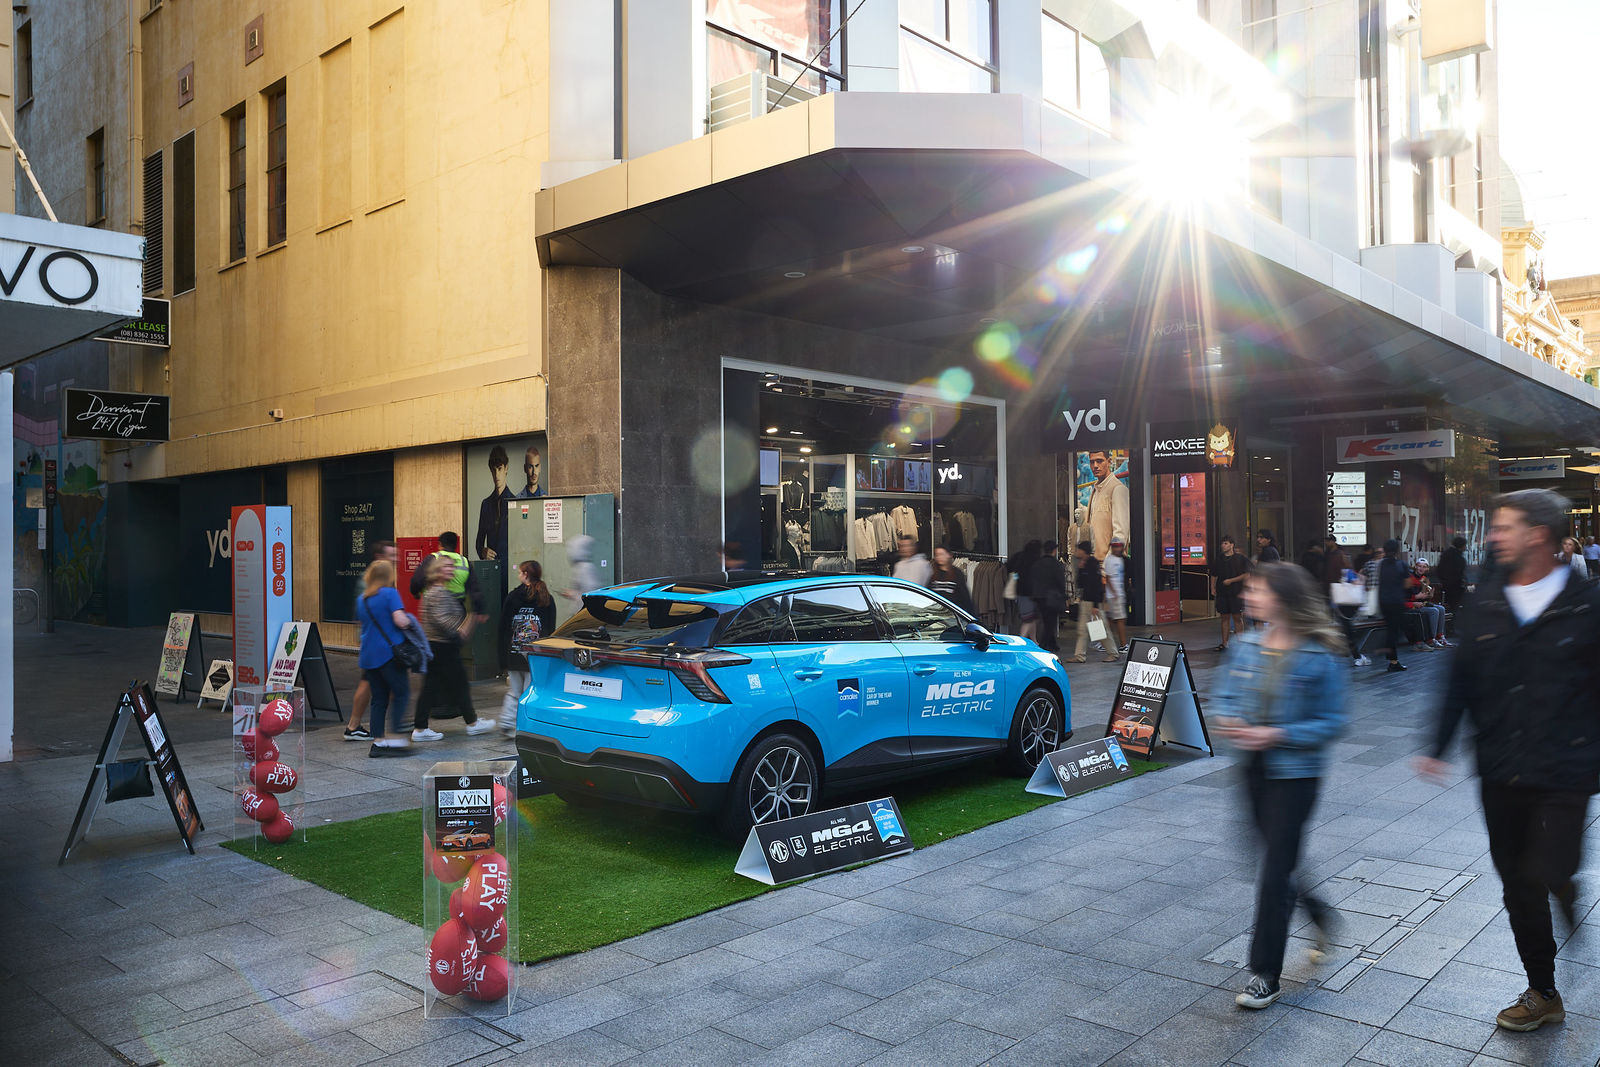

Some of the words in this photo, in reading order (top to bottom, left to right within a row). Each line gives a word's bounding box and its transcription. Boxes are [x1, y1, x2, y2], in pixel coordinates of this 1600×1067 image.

[139, 321, 166, 333] LEASE
[133, 331, 149, 339] 8362
[150, 333, 165, 341] 1555
[91, 416, 119, 431] 24:7
[116, 414, 148, 437] Gym
[1062, 399, 1117, 441] yd.
[1154, 437, 1205, 452] MOOKEE
[1343, 437, 1444, 459] Kmart
[937, 462, 963, 484] yd.
[1327, 472, 1335, 483] 7
[344, 504, 358, 515] Shop
[359, 503, 372, 514] 24/7
[1327, 496, 1335, 508] 5
[1327, 509, 1335, 521] 4
[1327, 521, 1335, 533] 3
[206, 518, 232, 568] yd
[275, 546, 284, 571] Twin
[276, 579, 285, 591] St
[581, 680, 604, 688] MG4
[1141, 669, 1168, 687] WIN
[839, 693, 859, 701] carsales
[925, 679, 995, 701] MG4
[1123, 685, 1136, 694] $1000
[1146, 690, 1163, 699] voucher
[921, 699, 994, 718] ELECTRIC
[1078, 752, 1110, 769] MG4
[1081, 761, 1113, 777] ELECTRIC
[266, 773, 296, 787] PLAY
[457, 794, 488, 806] WIN
[837, 817, 847, 825] NEW
[811, 819, 872, 844] MG4
[813, 832, 874, 855] ELECTRIC
[480, 863, 498, 912] PLAY
[495, 870, 508, 905] LET'S
